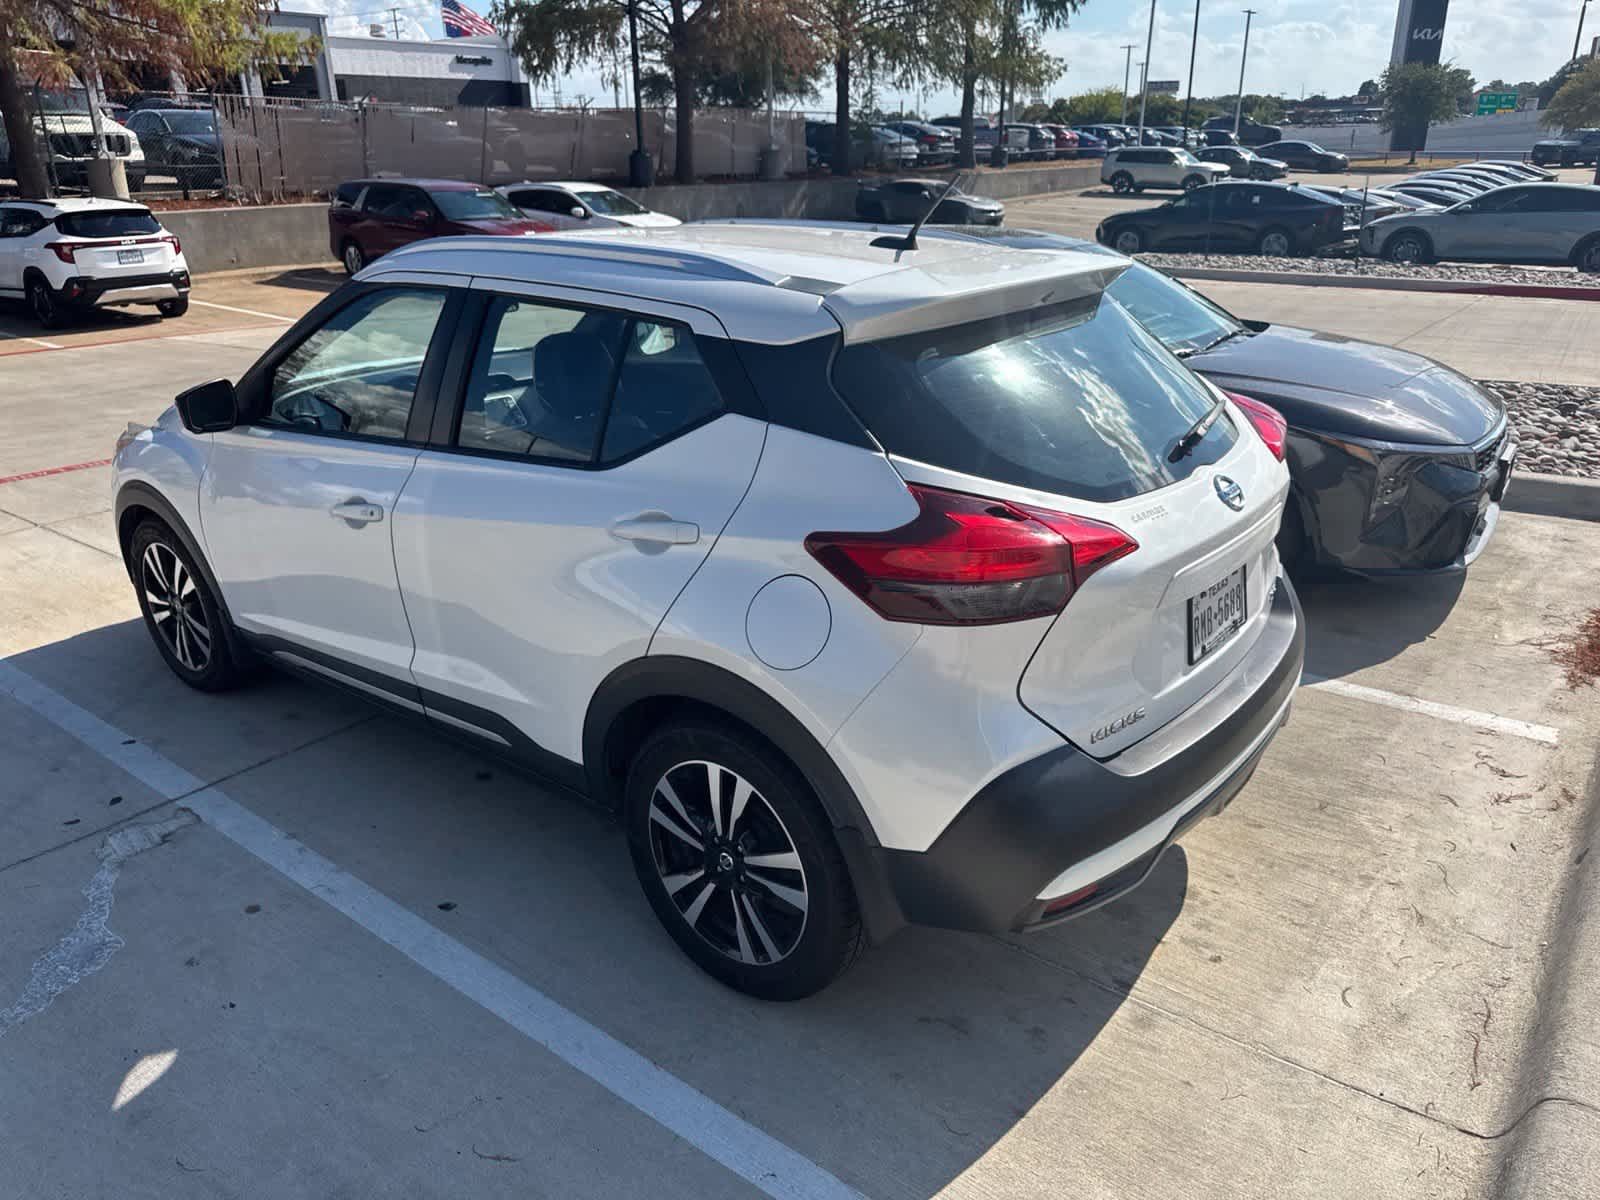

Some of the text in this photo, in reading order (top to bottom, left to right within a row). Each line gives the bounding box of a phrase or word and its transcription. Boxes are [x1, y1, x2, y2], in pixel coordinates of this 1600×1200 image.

[1412, 28, 1442, 40] KIA
[1208, 577, 1229, 599] TEXAS
[1090, 706, 1145, 745] KICKS
